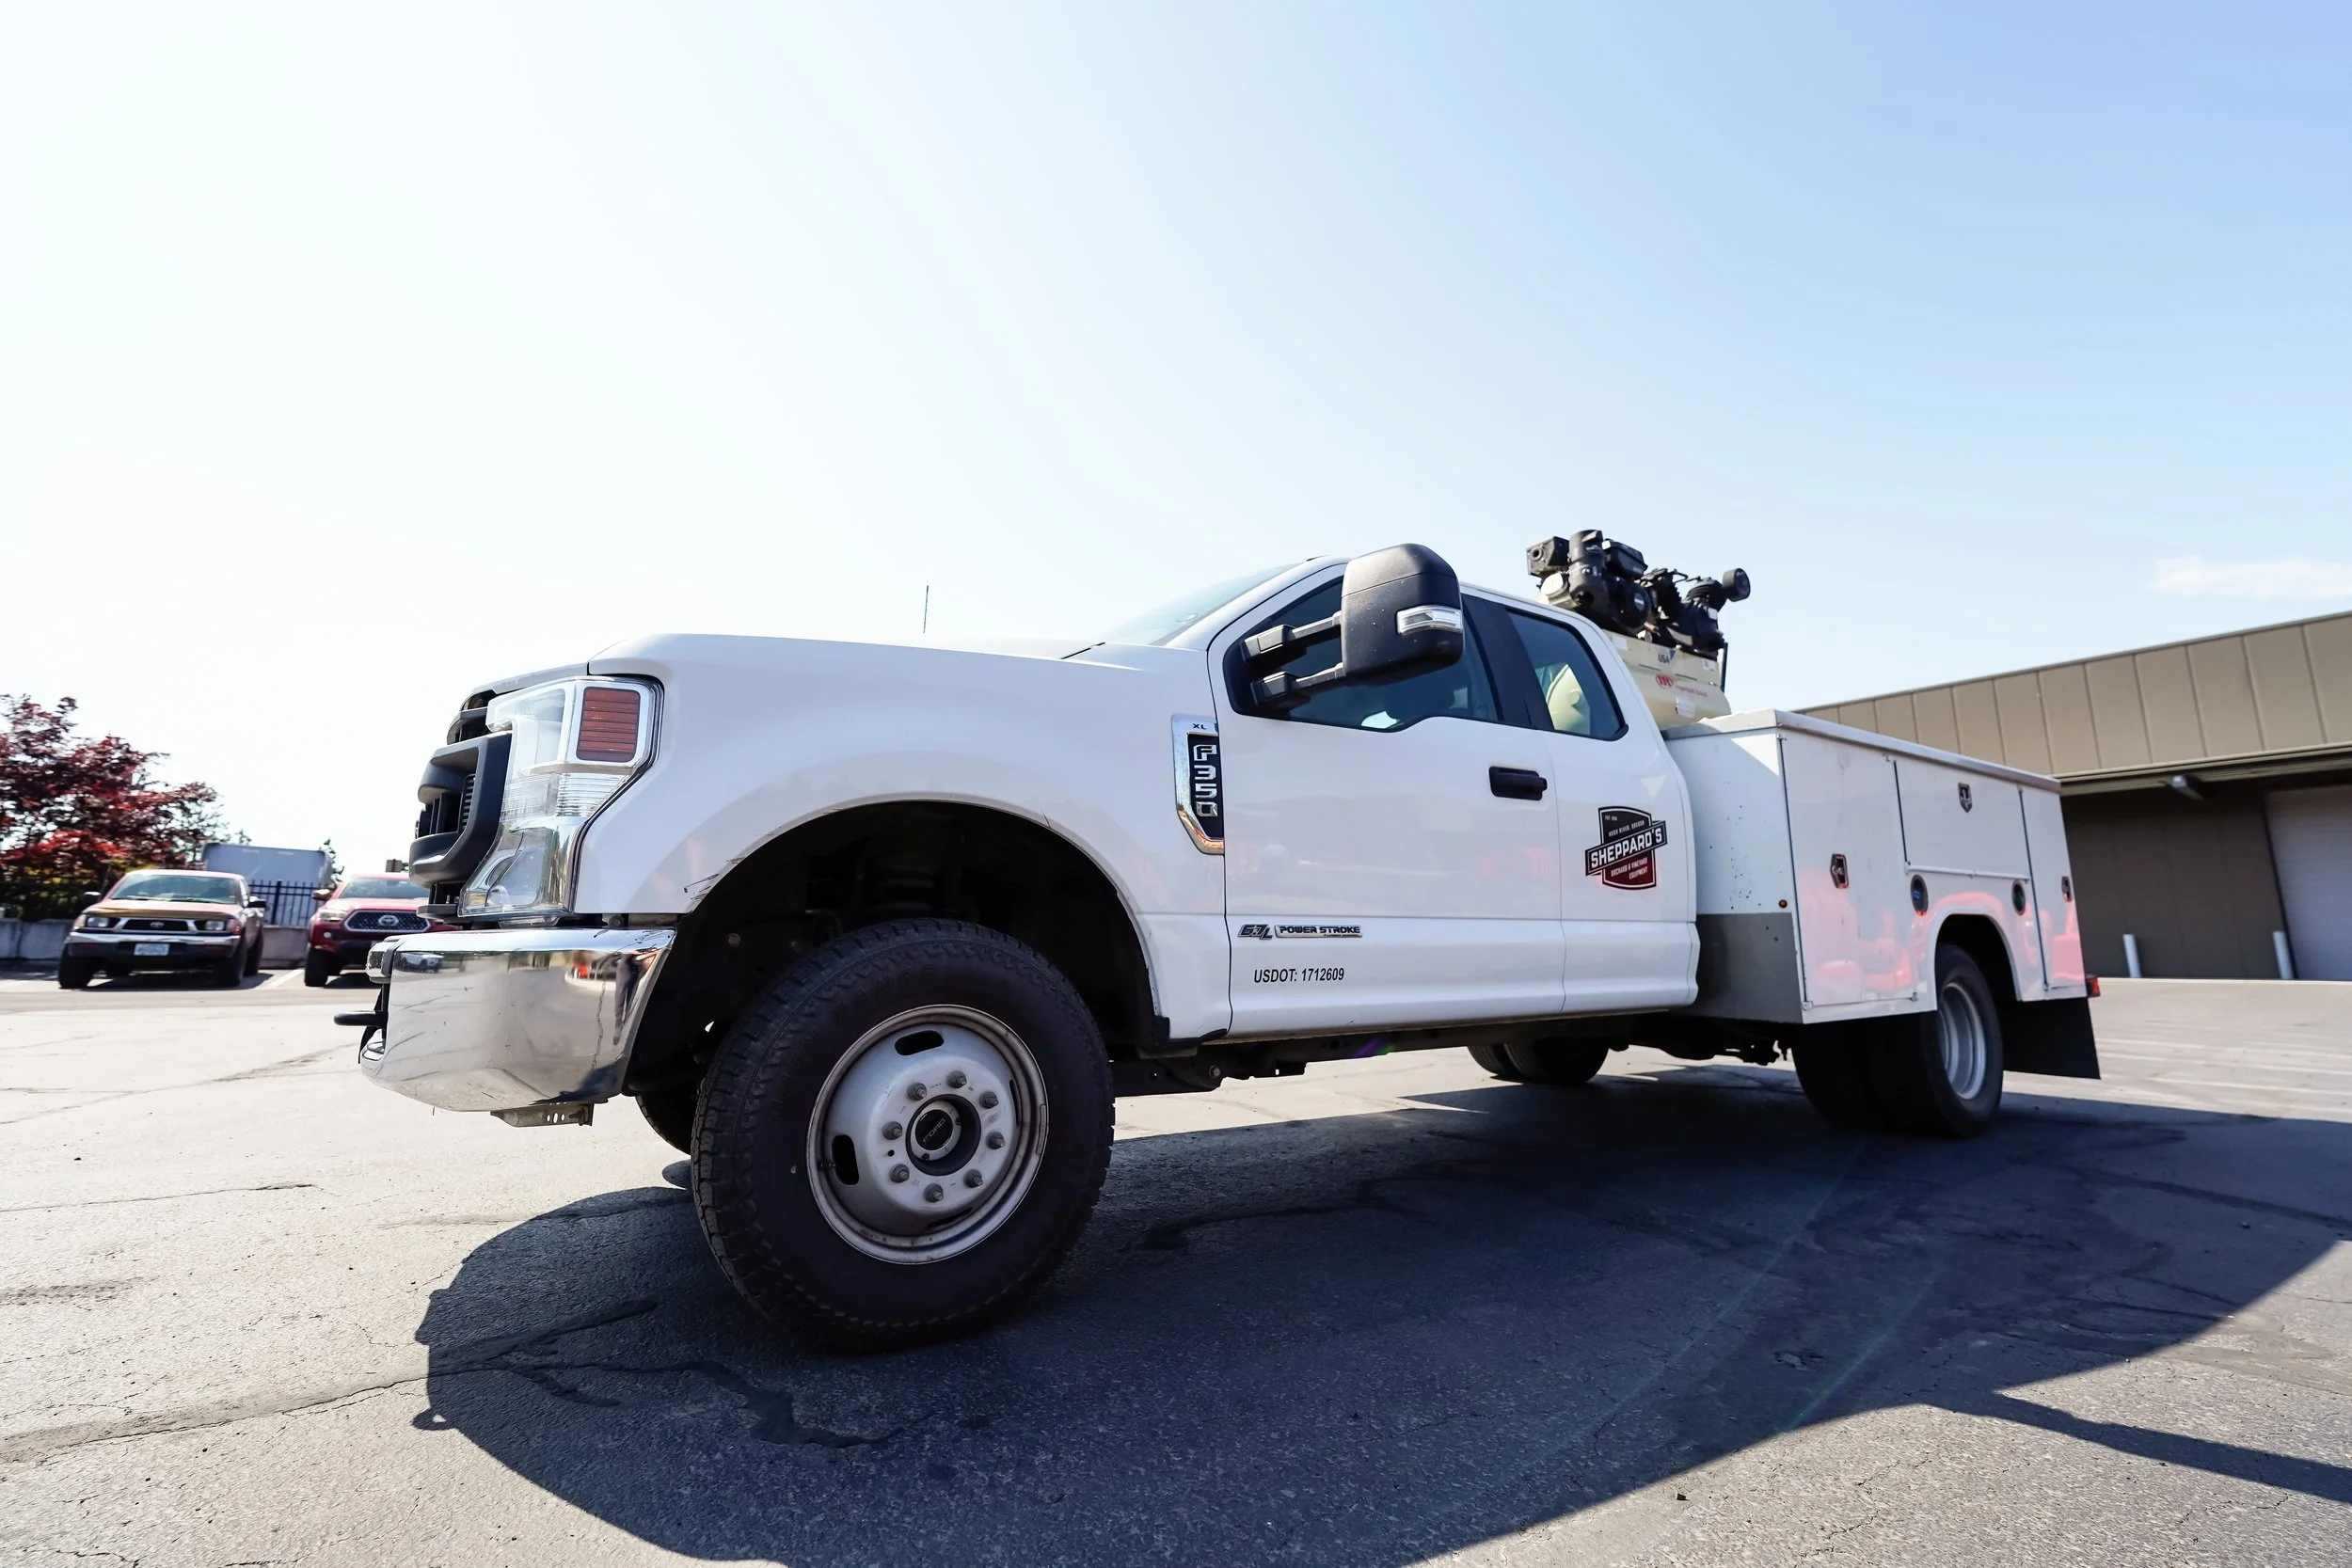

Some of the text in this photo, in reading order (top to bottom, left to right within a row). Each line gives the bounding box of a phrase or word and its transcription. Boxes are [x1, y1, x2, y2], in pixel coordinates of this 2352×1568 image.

[1658, 653, 1671, 664] USA
[1192, 744, 1218, 817] F350
[1591, 828, 1662, 868] SHEPPARD'S
[1239, 924, 1273, 940] 6.7L
[1279, 926, 1360, 934] POWER STROKE
[1253, 967, 1345, 984] USDOT: 1712609
[923, 1119, 946, 1143] FORD
